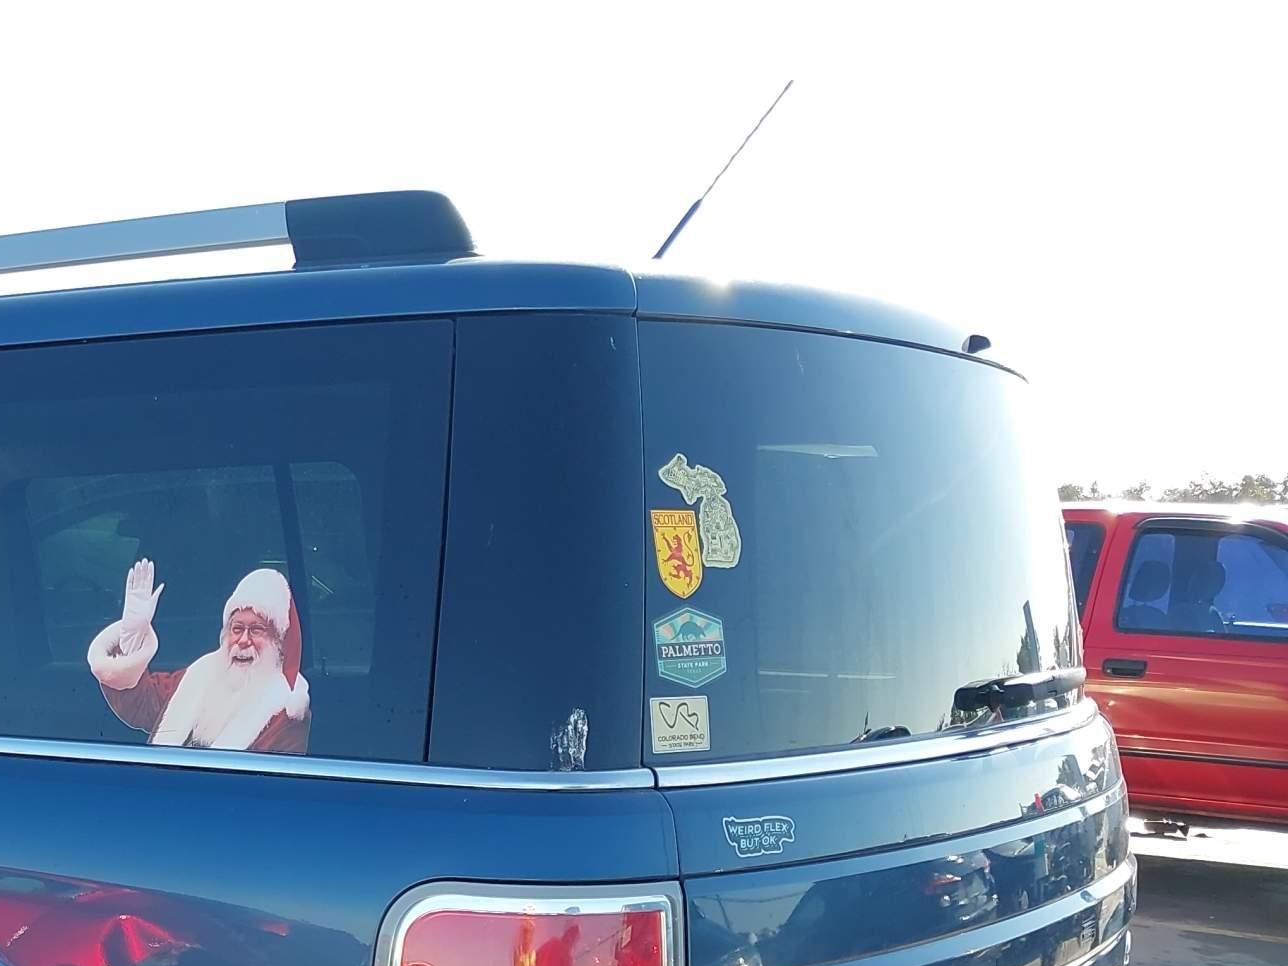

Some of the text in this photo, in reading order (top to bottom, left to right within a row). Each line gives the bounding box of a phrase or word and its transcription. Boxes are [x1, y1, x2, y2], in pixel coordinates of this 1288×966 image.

[653, 514, 693, 525] SCOTLAND
[661, 643, 721, 658] PALMETTO
[657, 734, 689, 742] COLORADO
[728, 822, 789, 836] WEIRD FLEX
[740, 835, 777, 849] BUT OK
